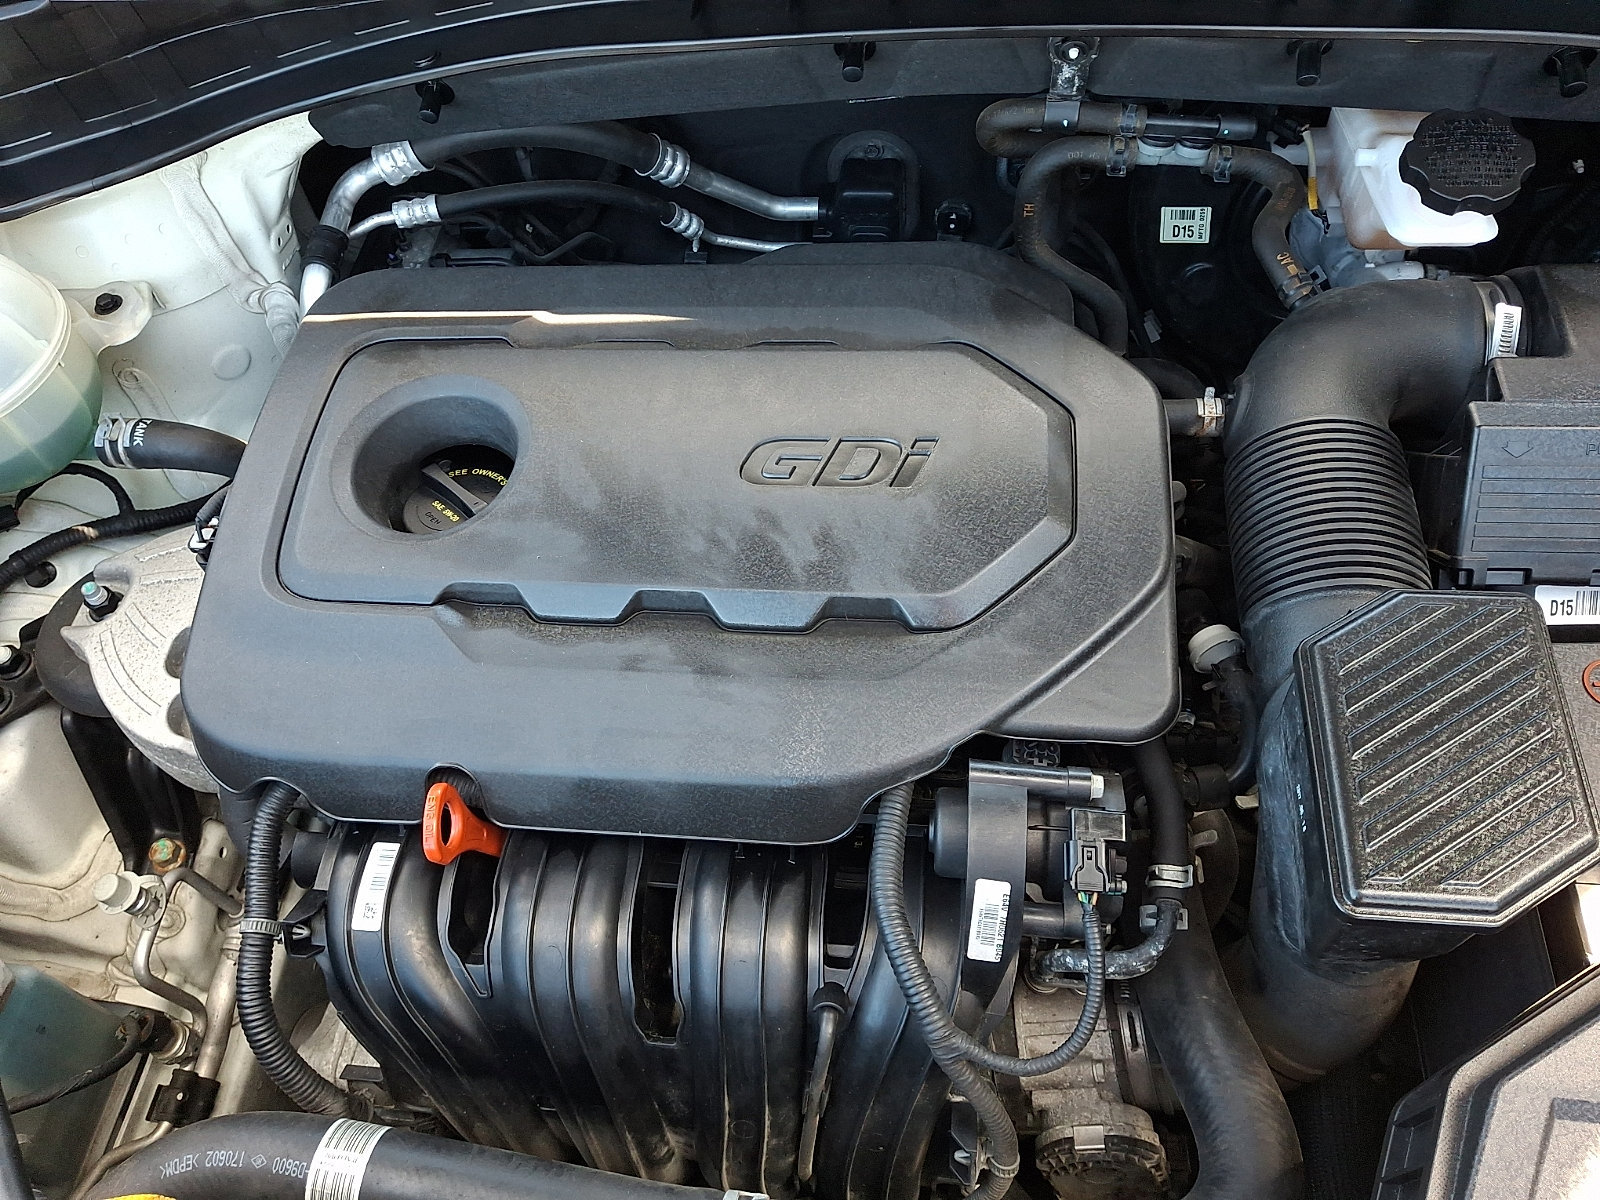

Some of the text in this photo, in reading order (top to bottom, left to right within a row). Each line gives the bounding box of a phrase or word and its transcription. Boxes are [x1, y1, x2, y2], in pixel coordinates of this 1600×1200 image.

[1172, 224, 1195, 239] D15
[132, 418, 153, 448] TANK
[739, 436, 941, 488] GDi
[448, 468, 508, 486] SEE OWNER'S
[431, 500, 446, 512] SAE
[424, 511, 442, 525] OPEN
[1550, 599, 1574, 617] D15
[425, 795, 436, 843] ENG OIL
[205, 1150, 246, 1168] 170602
